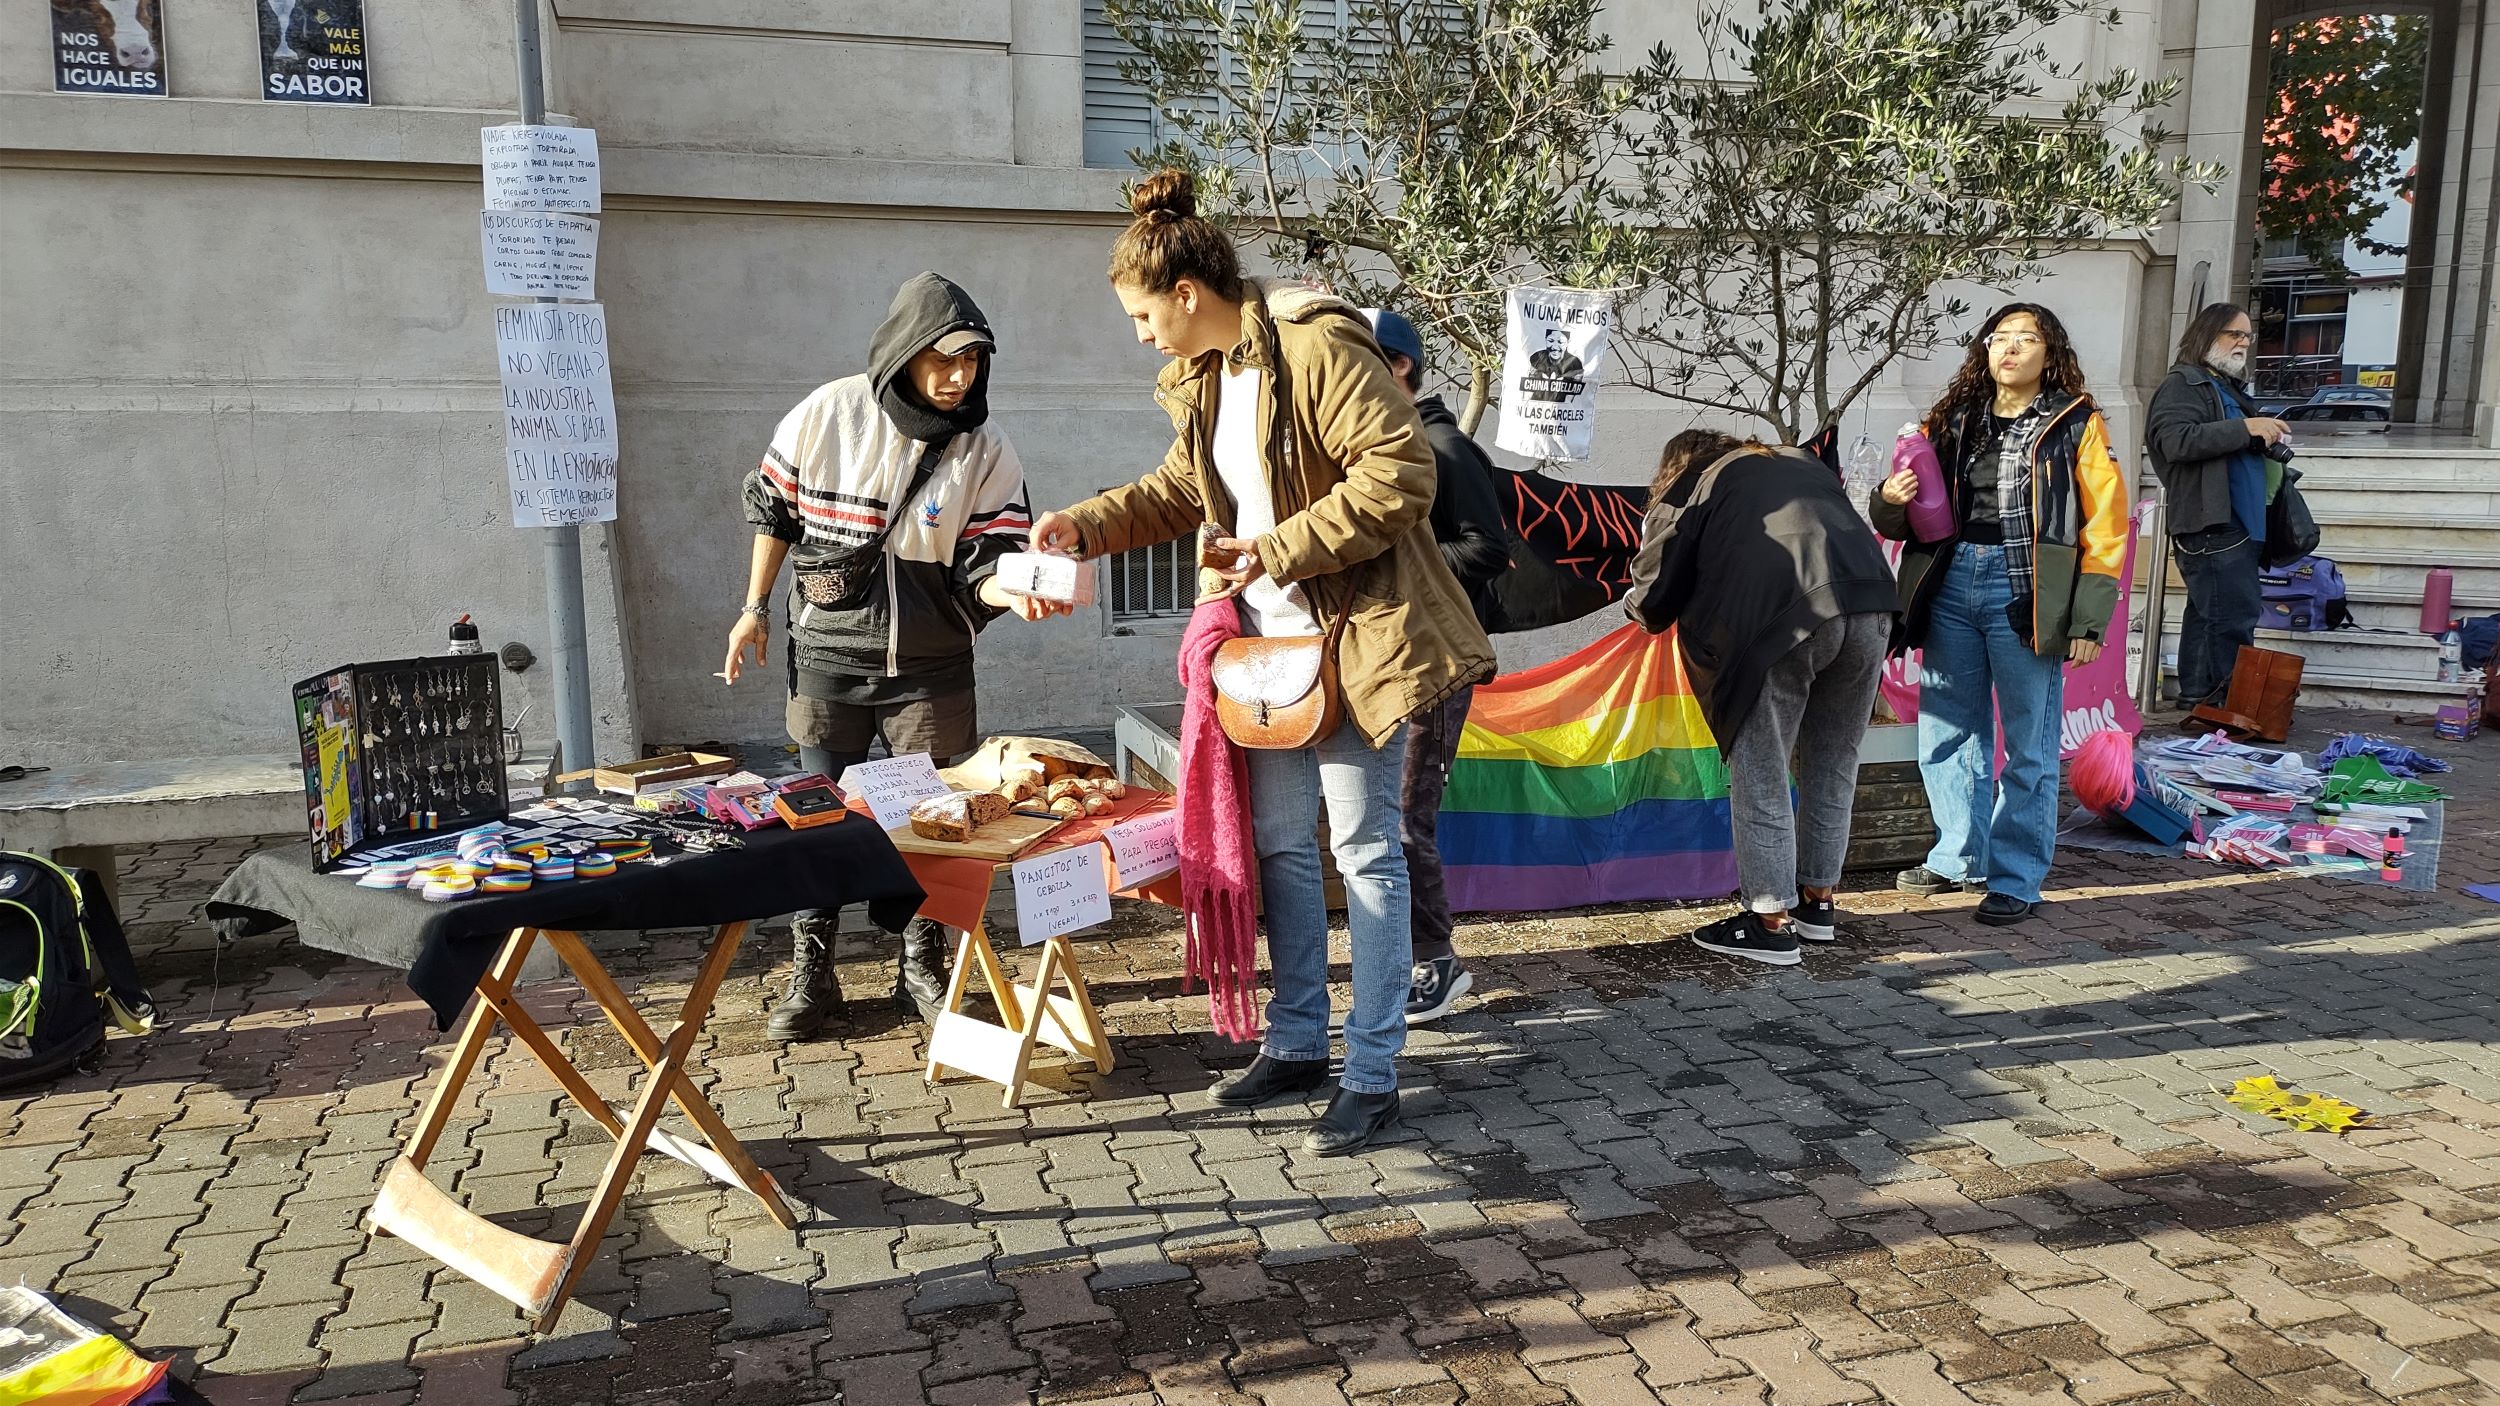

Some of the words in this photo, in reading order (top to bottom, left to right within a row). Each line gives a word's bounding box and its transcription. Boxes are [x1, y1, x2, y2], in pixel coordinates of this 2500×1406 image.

[61, 32, 98, 47] NOS
[324, 28, 360, 40] VALE
[329, 42, 361, 55] MÁS
[62, 50, 110, 66] HACE
[307, 57, 338, 71] QUE
[342, 59, 362, 71] UN
[63, 68, 158, 88] IGUALES
[269, 73, 364, 98] SABOR
[493, 198, 536, 210] FEMINISMO
[482, 212, 494, 229] TUS
[497, 216, 543, 229] DISCURSOS
[546, 218, 554, 228] DE
[488, 233, 494, 244] Y
[498, 234, 536, 244] SORORIDAD
[542, 236, 552, 244] TE
[1523, 302, 1535, 319] NI
[1538, 305, 1562, 323] UNA
[1566, 308, 1608, 327] MENOS
[496, 308, 563, 342] FEMINISTA
[568, 311, 602, 346] PERO
[508, 352, 532, 374] NO
[537, 350, 605, 380] VEGANA?
[1524, 378, 1549, 392] CHINA
[1550, 380, 1583, 394] CUELLAR
[504, 386, 522, 408] LA
[1524, 407, 1543, 420] LAS
[1544, 406, 1584, 421] CÁRCELES
[511, 415, 562, 442] ANIMAL
[564, 415, 577, 438] SE
[582, 415, 606, 442] BASA
[1529, 423, 1568, 436] TAMBIÉN
[514, 450, 536, 482] EN
[544, 450, 562, 482] LA
[514, 490, 532, 508] DEL
[536, 488, 575, 507] SISTEMA
[542, 506, 598, 523] FEMENINO
[864, 780, 910, 794] BANANA
[878, 795, 896, 804] CHIP
[1112, 828, 1134, 839] MESA
[1134, 817, 1174, 832] SOLIDARIA
[1121, 846, 1141, 860] PARA
[1144, 834, 1175, 852] PRESAS
[1077, 856, 1088, 868] DE
[1048, 913, 1080, 934] (VEGAN)
